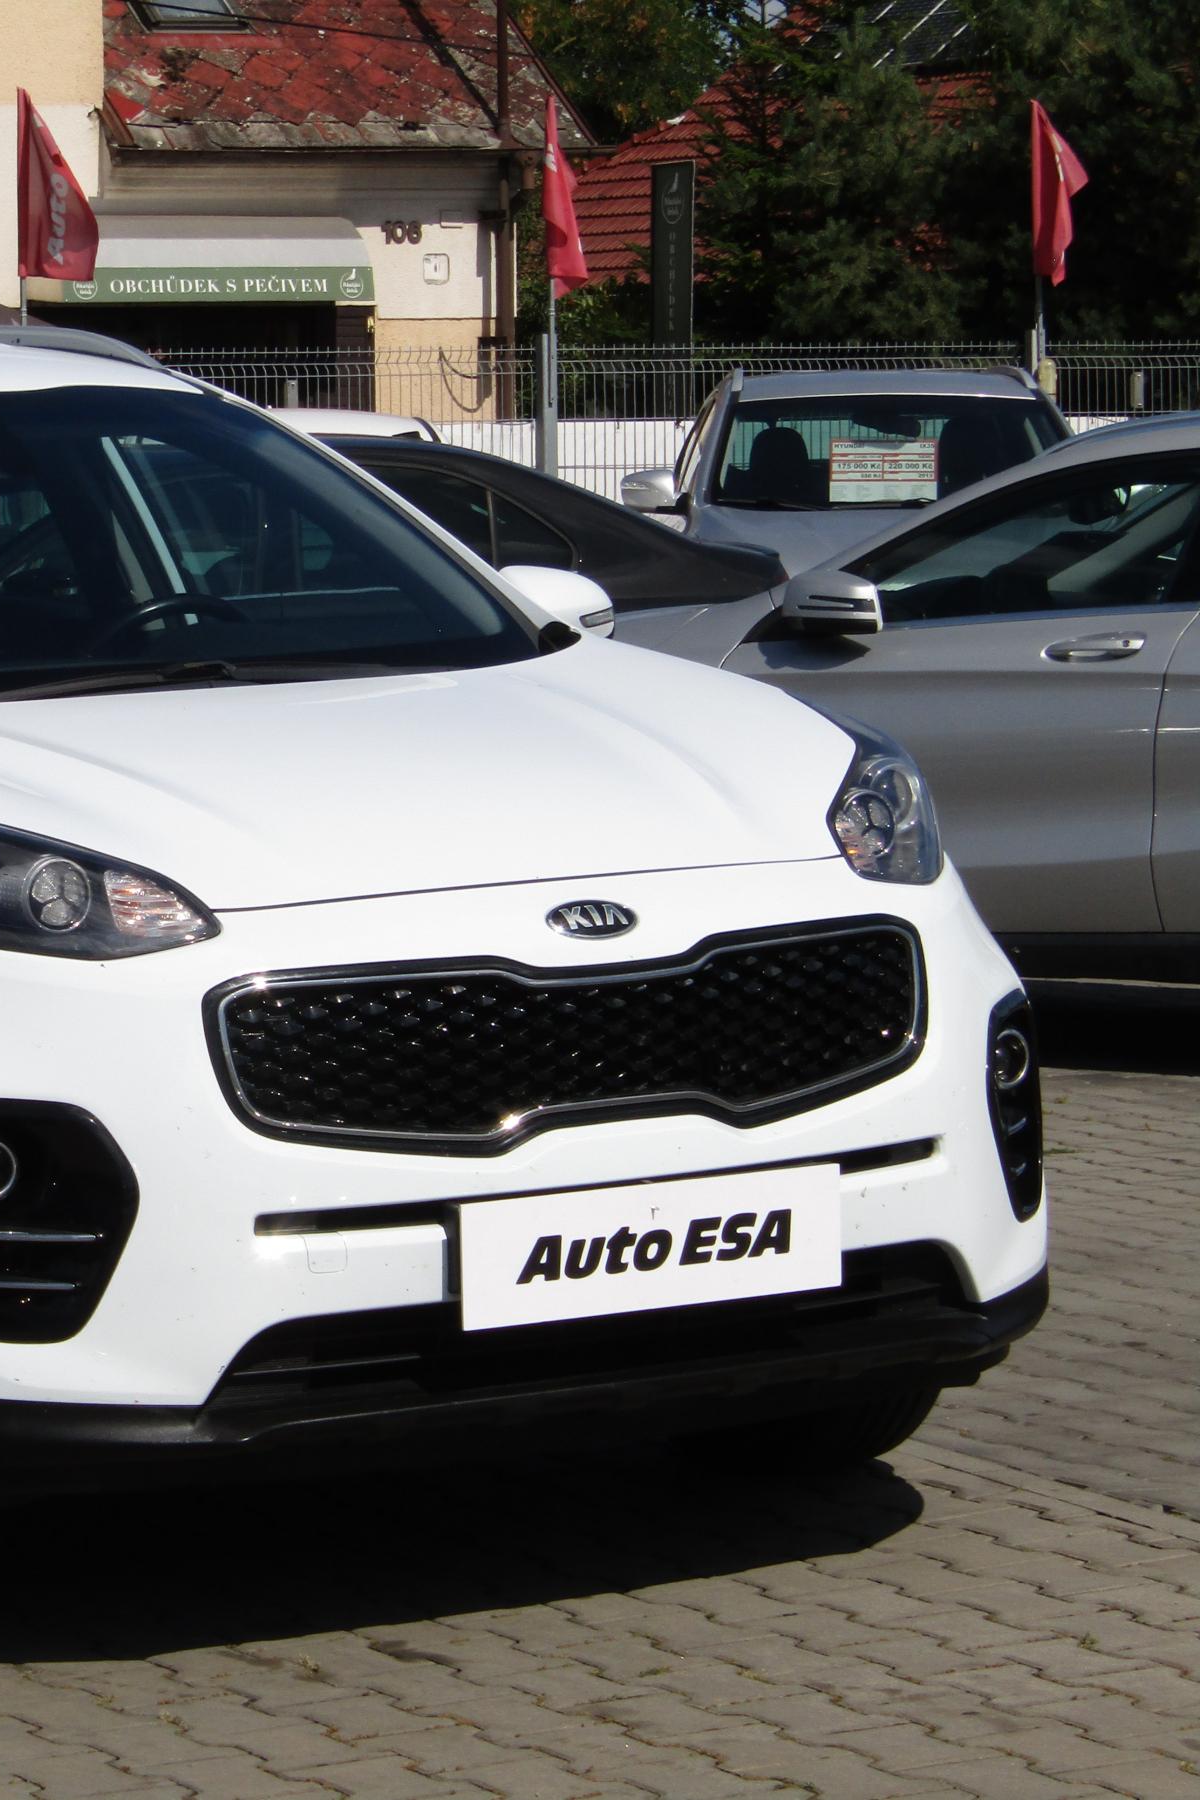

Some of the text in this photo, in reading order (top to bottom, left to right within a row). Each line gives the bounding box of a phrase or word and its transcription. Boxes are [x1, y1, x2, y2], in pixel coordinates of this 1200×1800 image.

[381, 221, 422, 245] 106
[226, 279, 237, 293] S
[243, 275, 328, 293] PEČIVEM
[558, 903, 629, 930] KIA
[515, 1208, 793, 1285] Auto ESA
